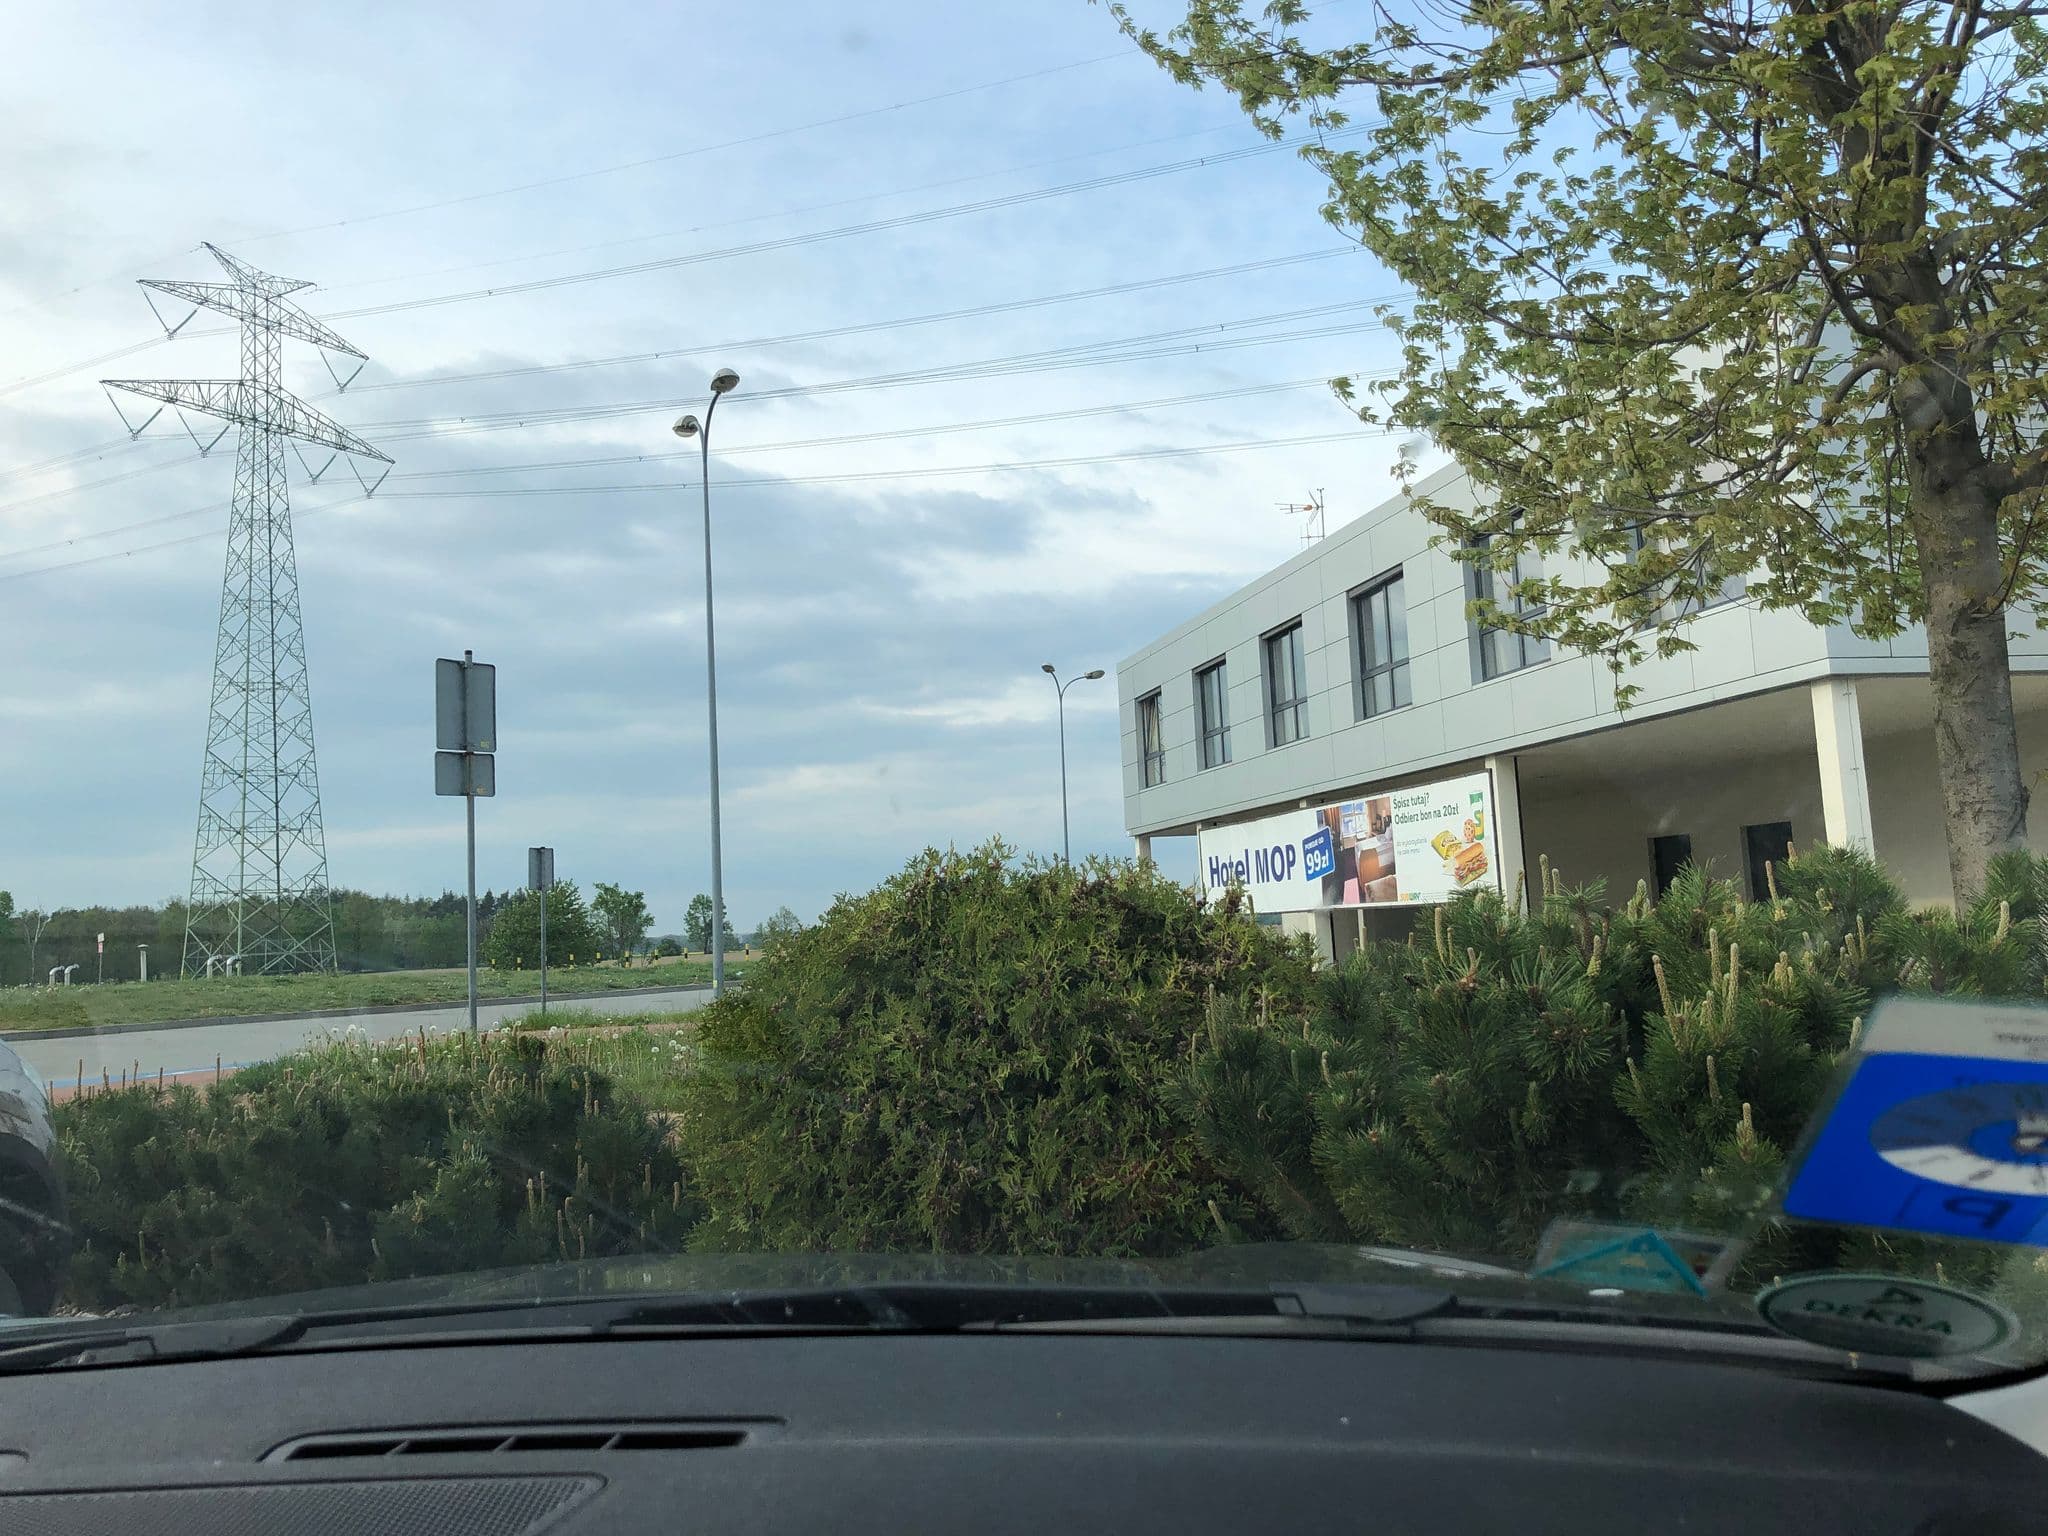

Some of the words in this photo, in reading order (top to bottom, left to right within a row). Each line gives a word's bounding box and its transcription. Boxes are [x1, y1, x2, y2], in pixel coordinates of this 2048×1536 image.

[1411, 792, 1430, 807] tutaj?
[1394, 811, 1420, 825] Odbierz
[1420, 810, 1433, 821] bon
[1433, 808, 1441, 818] na
[1442, 803, 1459, 817] 20zł
[1208, 849, 1250, 888] Hotel
[1255, 844, 1296, 883] MOP
